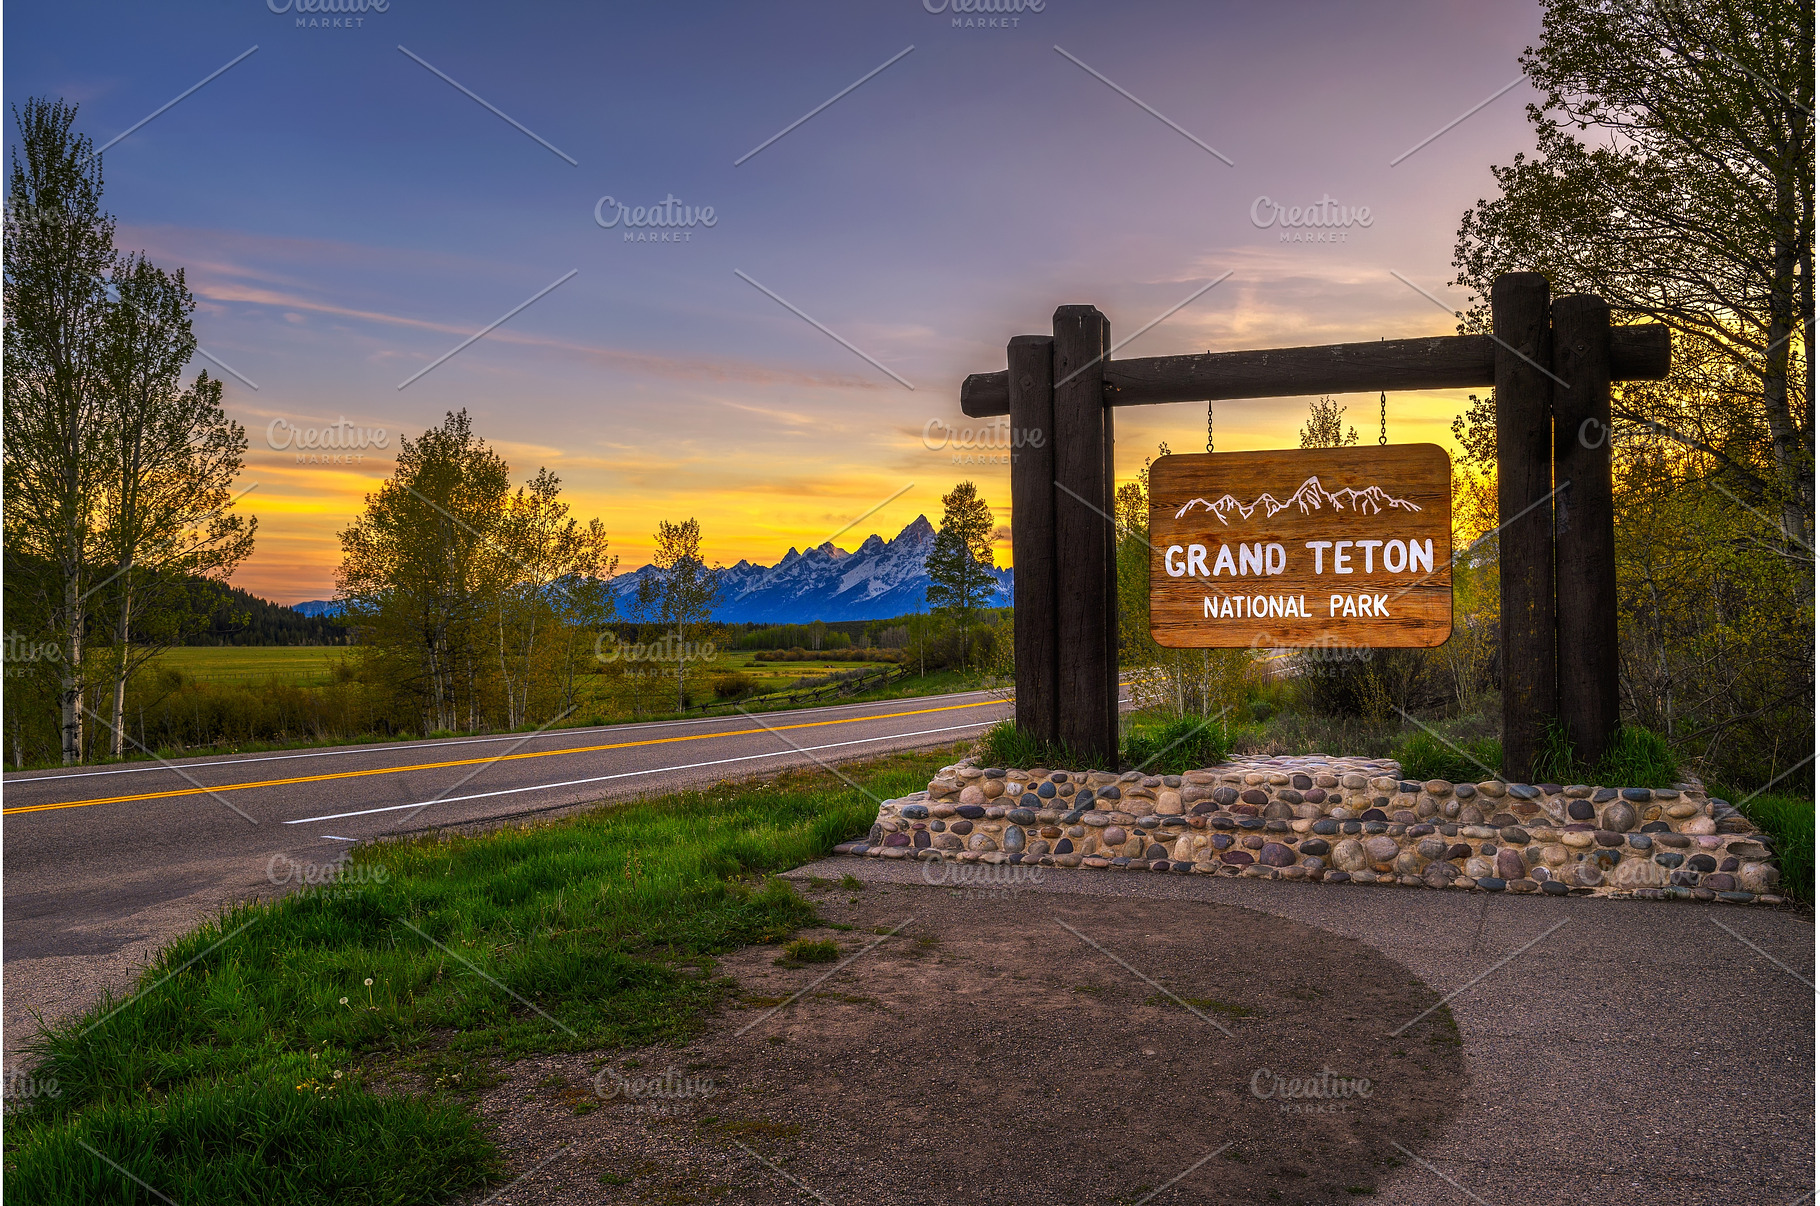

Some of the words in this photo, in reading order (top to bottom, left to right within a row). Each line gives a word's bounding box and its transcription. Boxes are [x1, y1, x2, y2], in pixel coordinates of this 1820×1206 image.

[1164, 542, 1287, 578] GRAND
[1305, 538, 1434, 575] TETON
[1204, 594, 1312, 619] NATIONAL
[1330, 594, 1390, 618] PARK
